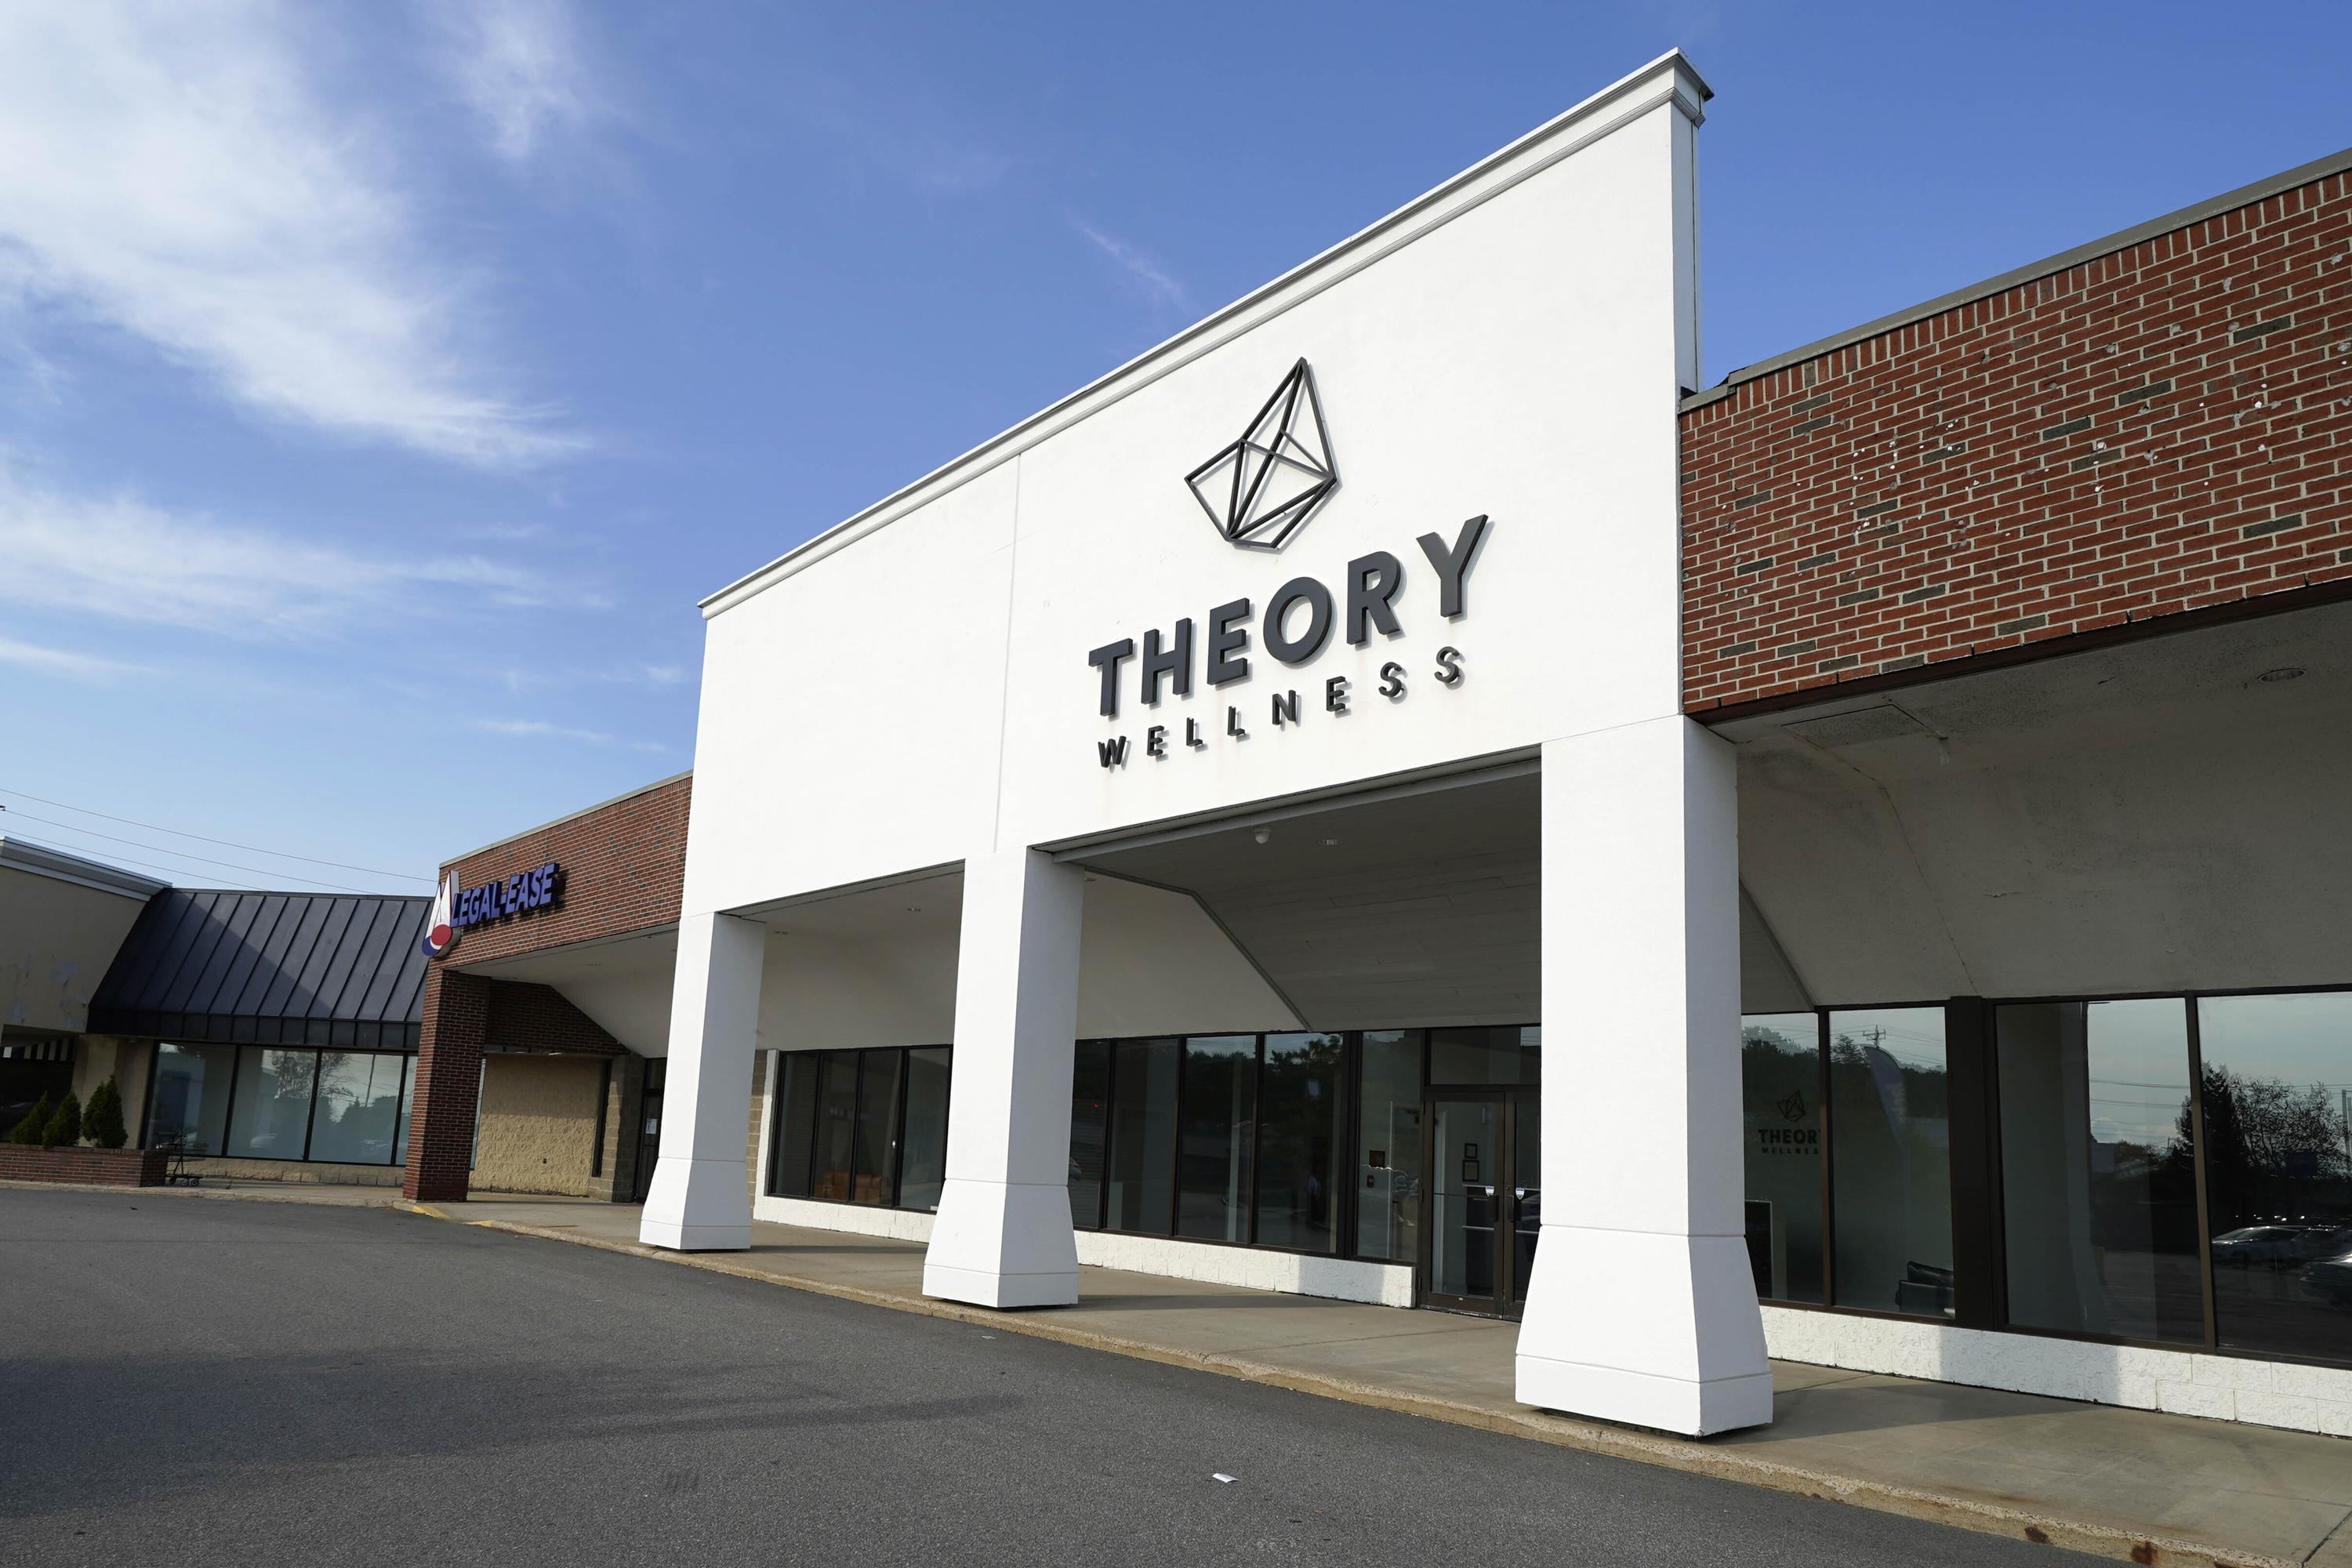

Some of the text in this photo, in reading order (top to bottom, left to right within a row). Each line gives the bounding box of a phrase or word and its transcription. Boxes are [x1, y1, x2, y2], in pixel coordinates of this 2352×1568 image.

[1088, 514, 1488, 717] THEORY
[1098, 646, 1461, 768] WELLNESS
[450, 862, 560, 928] LEGAL-EASE
[1758, 1129, 1820, 1145] THEOR
